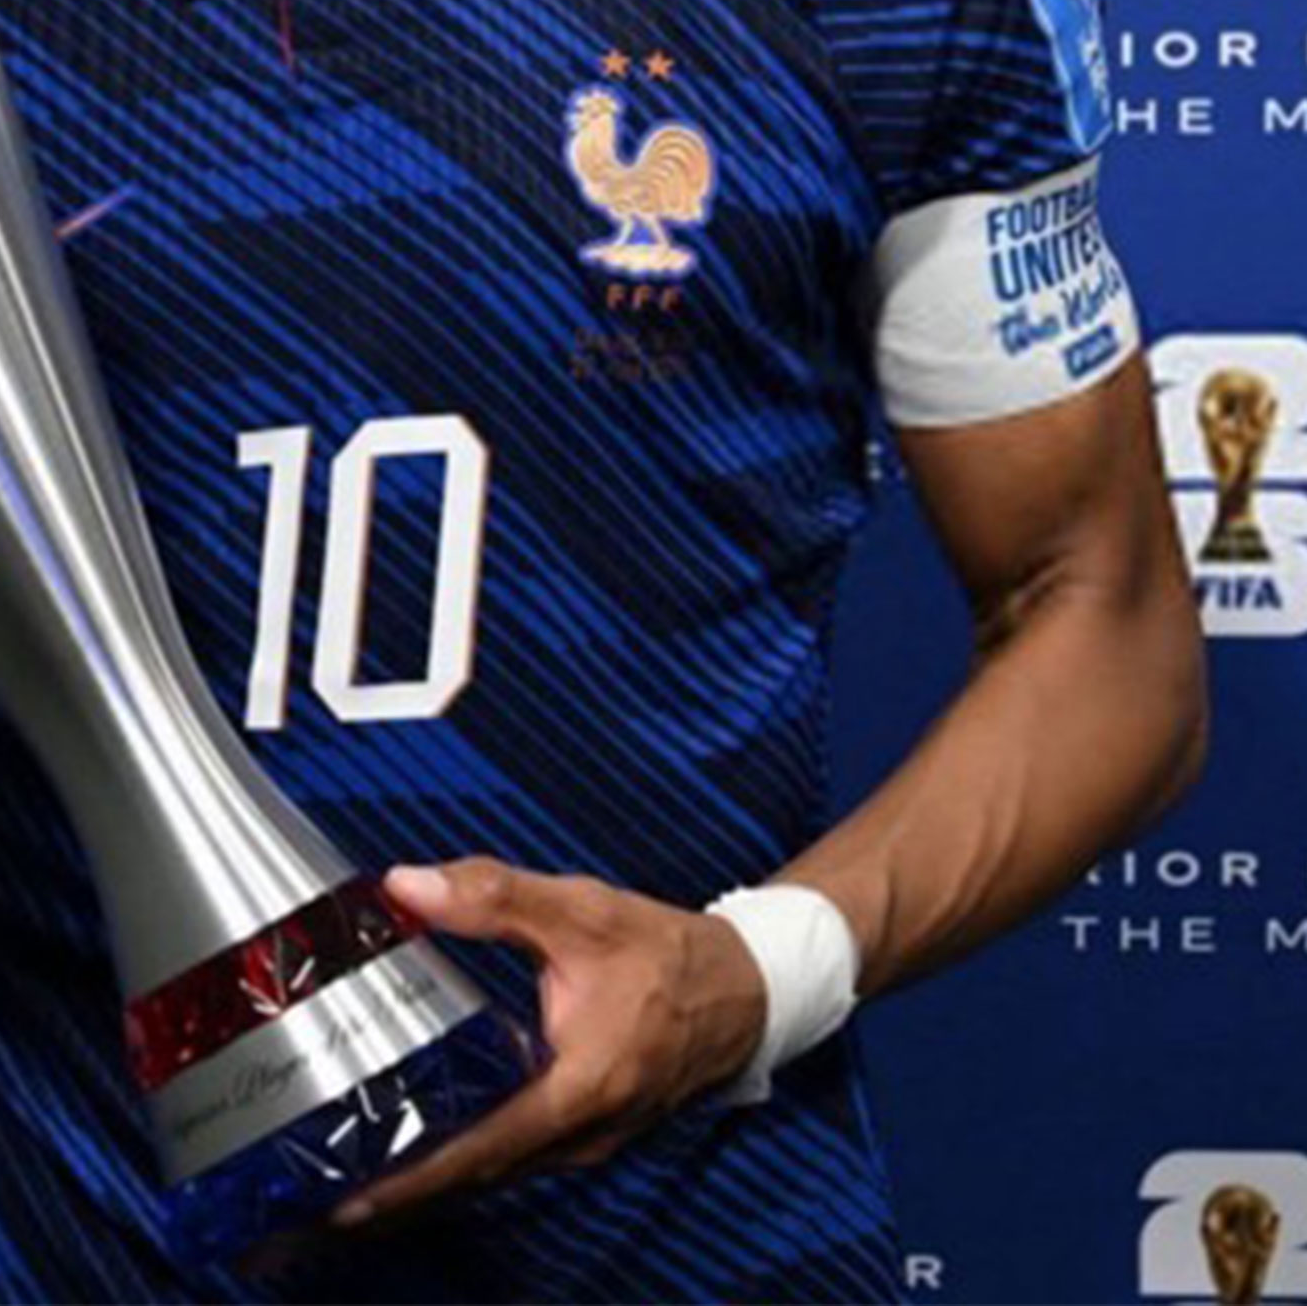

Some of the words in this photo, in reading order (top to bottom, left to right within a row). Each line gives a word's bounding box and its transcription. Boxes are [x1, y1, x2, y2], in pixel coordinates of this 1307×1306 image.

[1117, 98, 1213, 135] HE
[237, 413, 488, 730] 10
[1193, 575, 1283, 610] FIFA
[1062, 915, 1215, 953] THE
